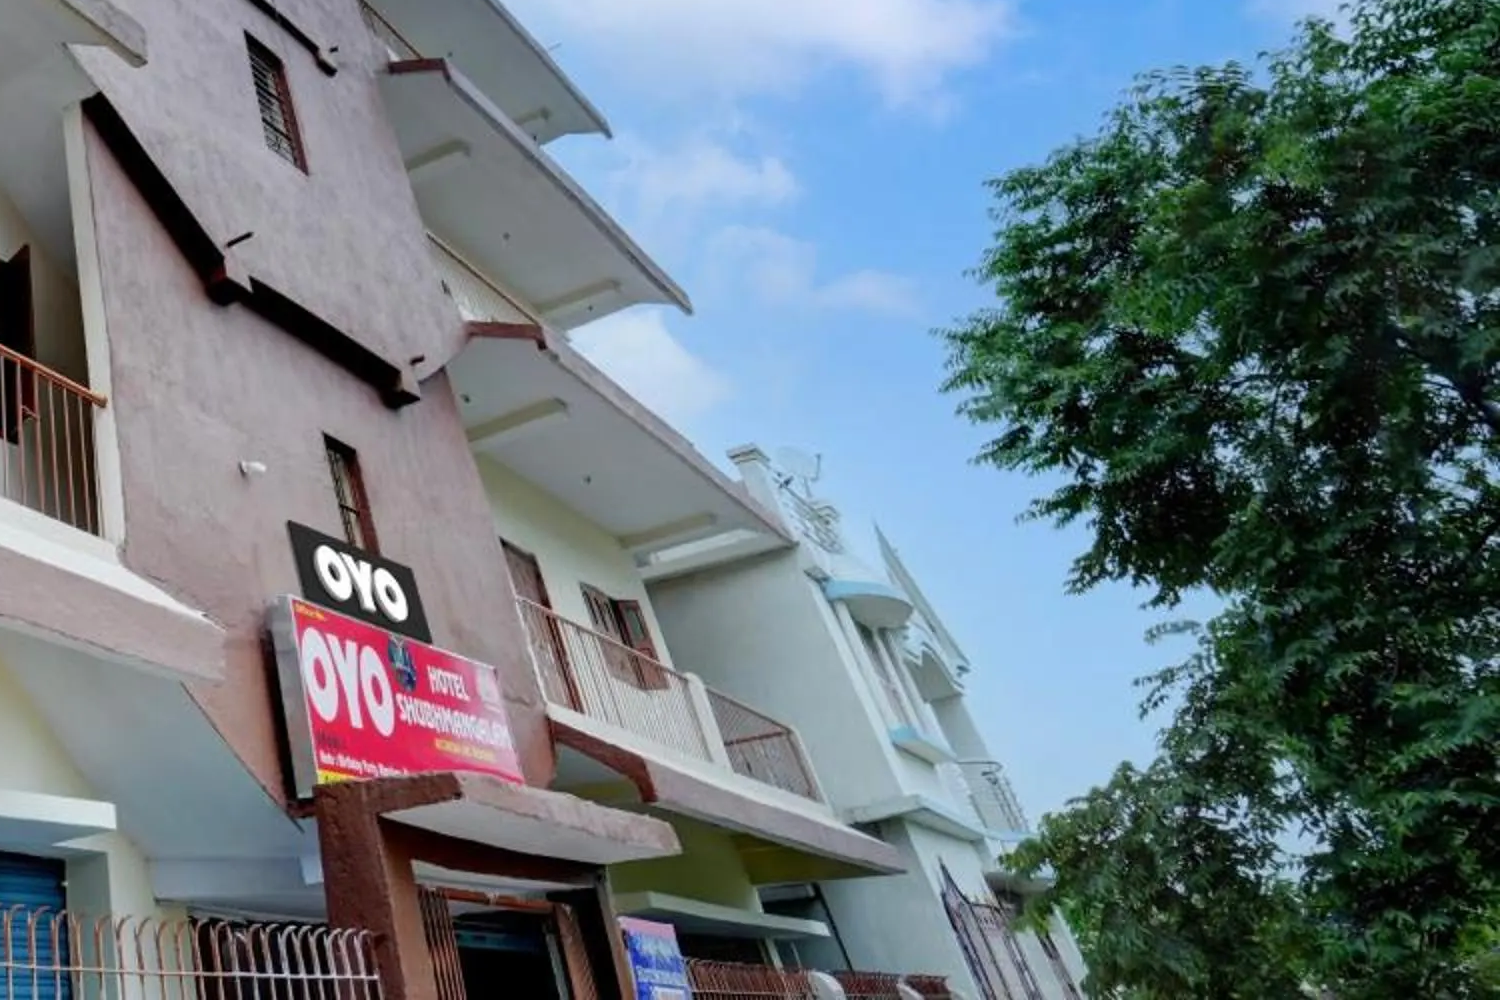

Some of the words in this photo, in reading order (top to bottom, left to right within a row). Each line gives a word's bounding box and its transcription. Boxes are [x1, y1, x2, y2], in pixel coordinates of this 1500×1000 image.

[314, 545, 409, 622] OYO
[301, 627, 395, 737] OYO
[427, 664, 471, 701] HOTEL
